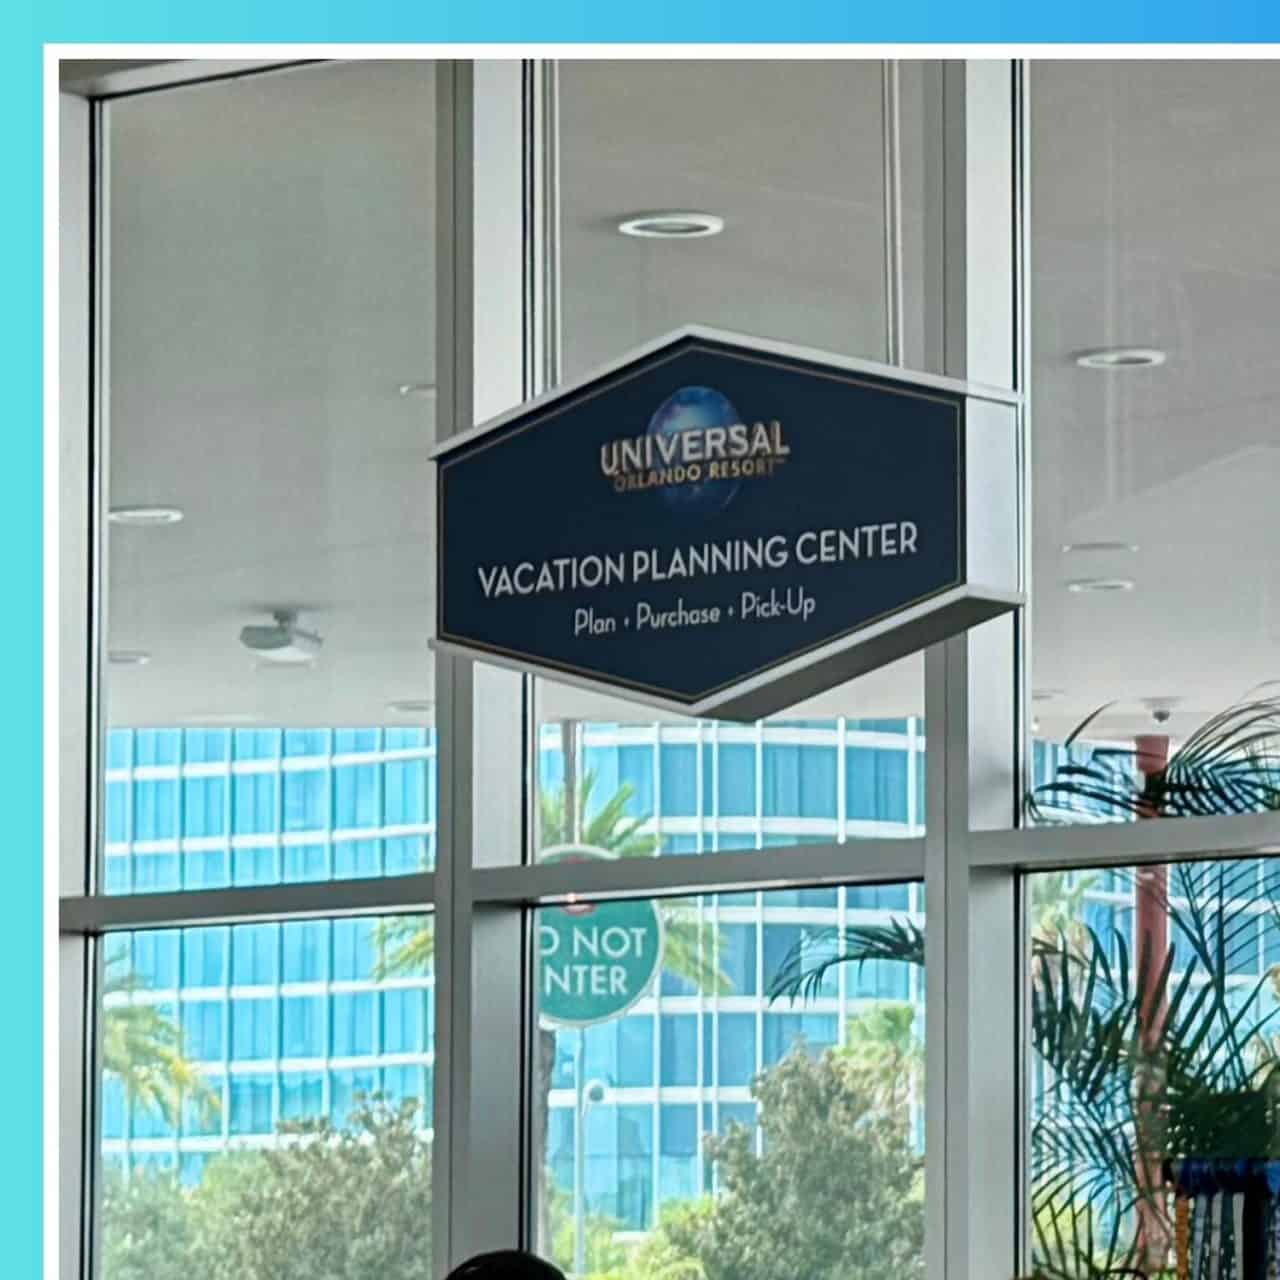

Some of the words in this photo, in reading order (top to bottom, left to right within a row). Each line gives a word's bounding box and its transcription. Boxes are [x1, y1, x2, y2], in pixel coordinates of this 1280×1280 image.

[600, 420, 791, 475] UNIVERSAL
[614, 464, 701, 492] ORLANDO
[477, 551, 626, 598] VACATION
[632, 535, 789, 583] PLANNING
[796, 521, 918, 563] CENTER
[574, 607, 616, 637] Plan
[636, 598, 721, 631] Purchase
[742, 587, 816, 622] Pick-Up
[539, 926, 560, 956] O
[572, 926, 647, 959] NOT
[545, 965, 628, 997] NTER
